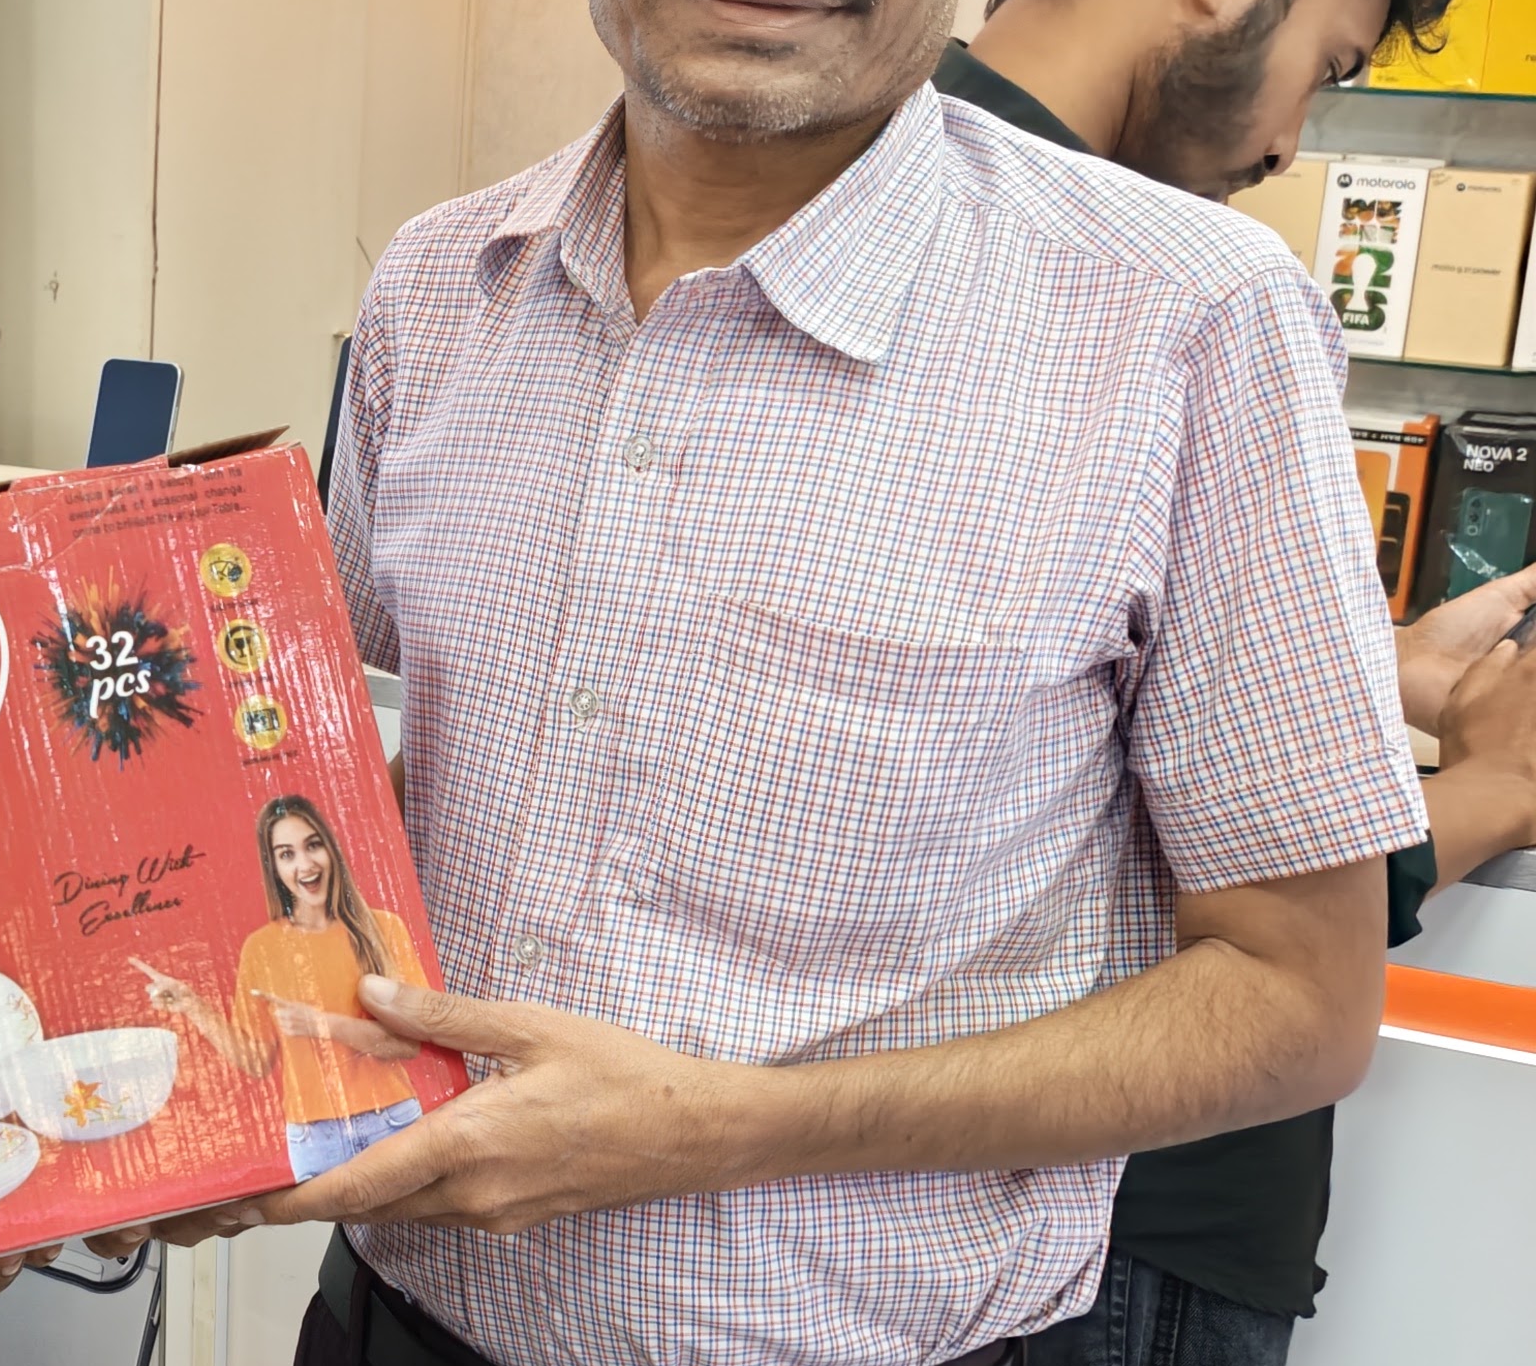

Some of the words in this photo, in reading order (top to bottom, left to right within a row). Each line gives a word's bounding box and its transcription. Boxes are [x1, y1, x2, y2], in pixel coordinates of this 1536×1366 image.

[1356, 176, 1417, 191] motorola
[1341, 311, 1370, 326] FIFA
[1465, 443, 1513, 461] NOVA
[1516, 446, 1528, 462] 2
[1463, 457, 1495, 473] NEO
[85, 630, 139, 671] 32
[89, 669, 152, 719] pcs
[54, 871, 129, 906] Dining
